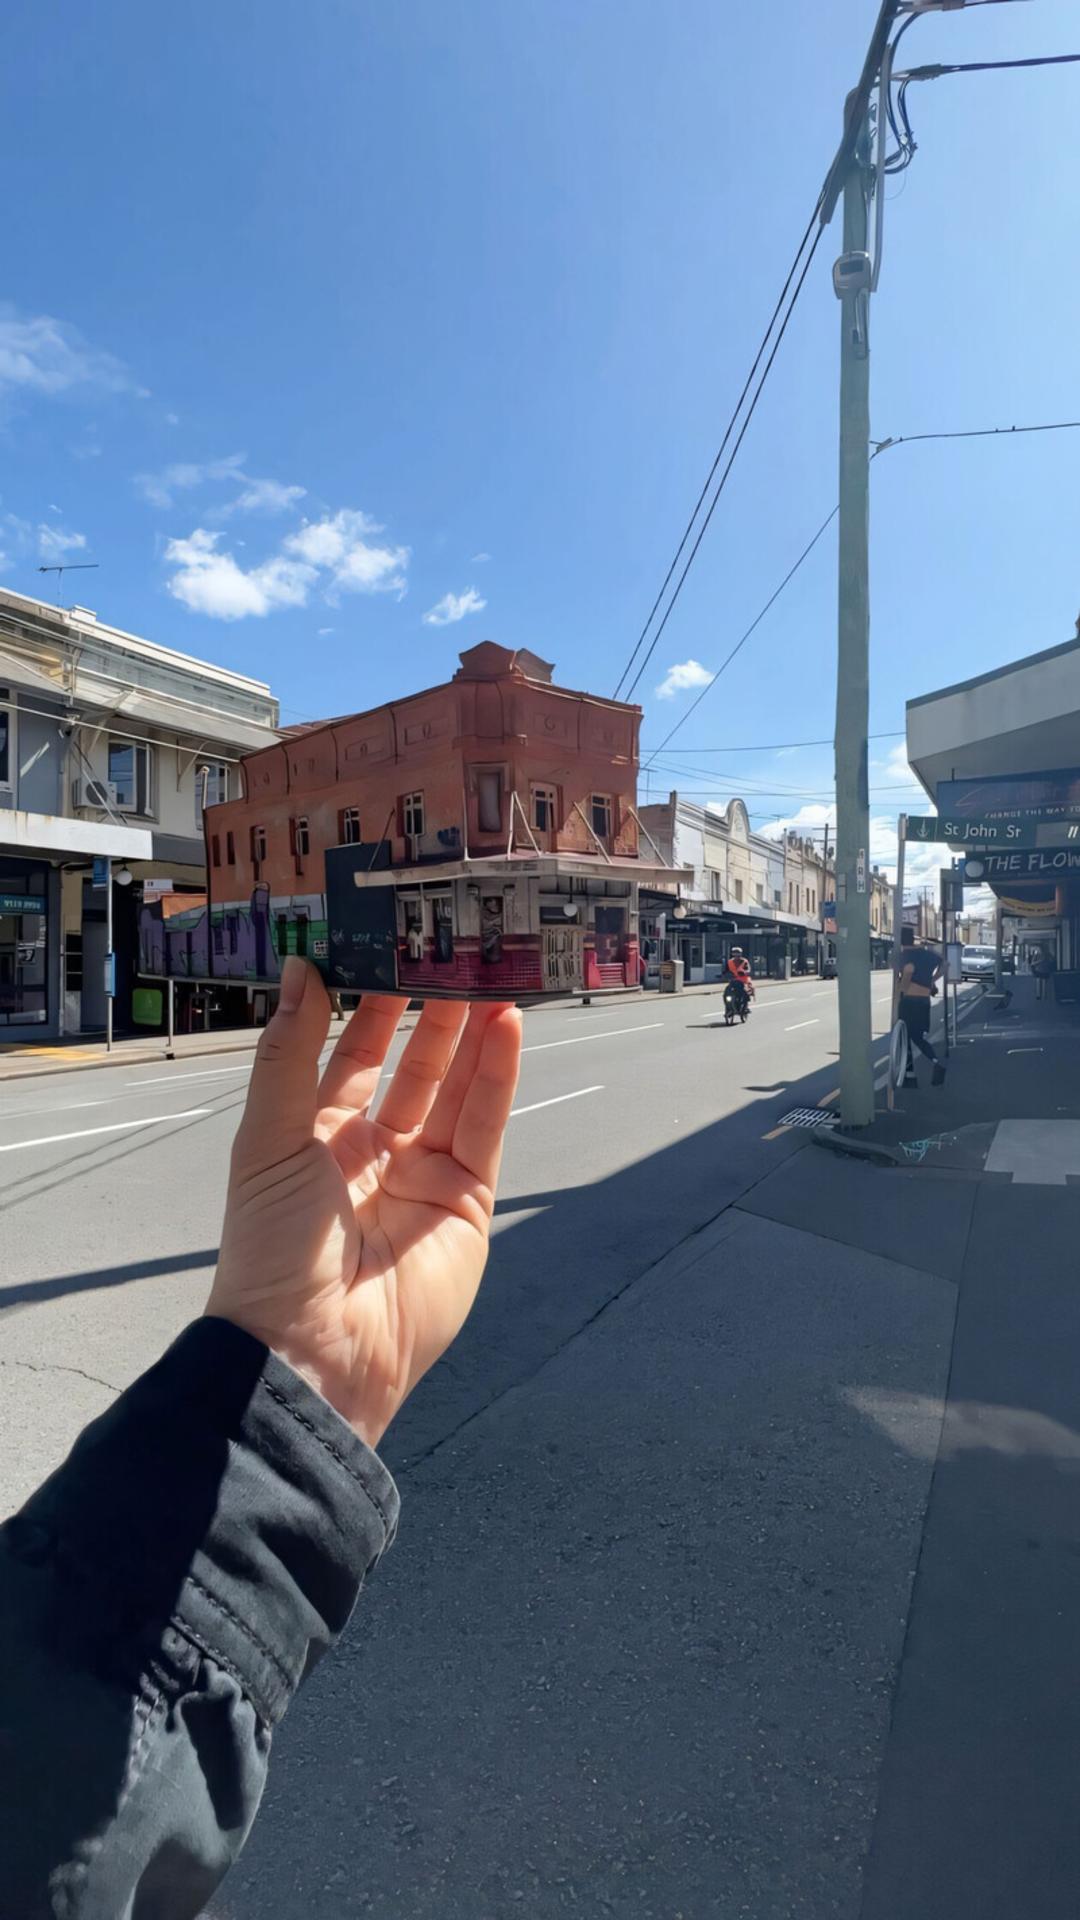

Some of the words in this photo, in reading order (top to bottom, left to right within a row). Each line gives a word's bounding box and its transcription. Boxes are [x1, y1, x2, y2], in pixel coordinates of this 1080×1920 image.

[944, 822, 959, 836] St
[963, 823, 997, 839] John
[1006, 824, 1022, 838] St
[985, 854, 1022, 872] THE
